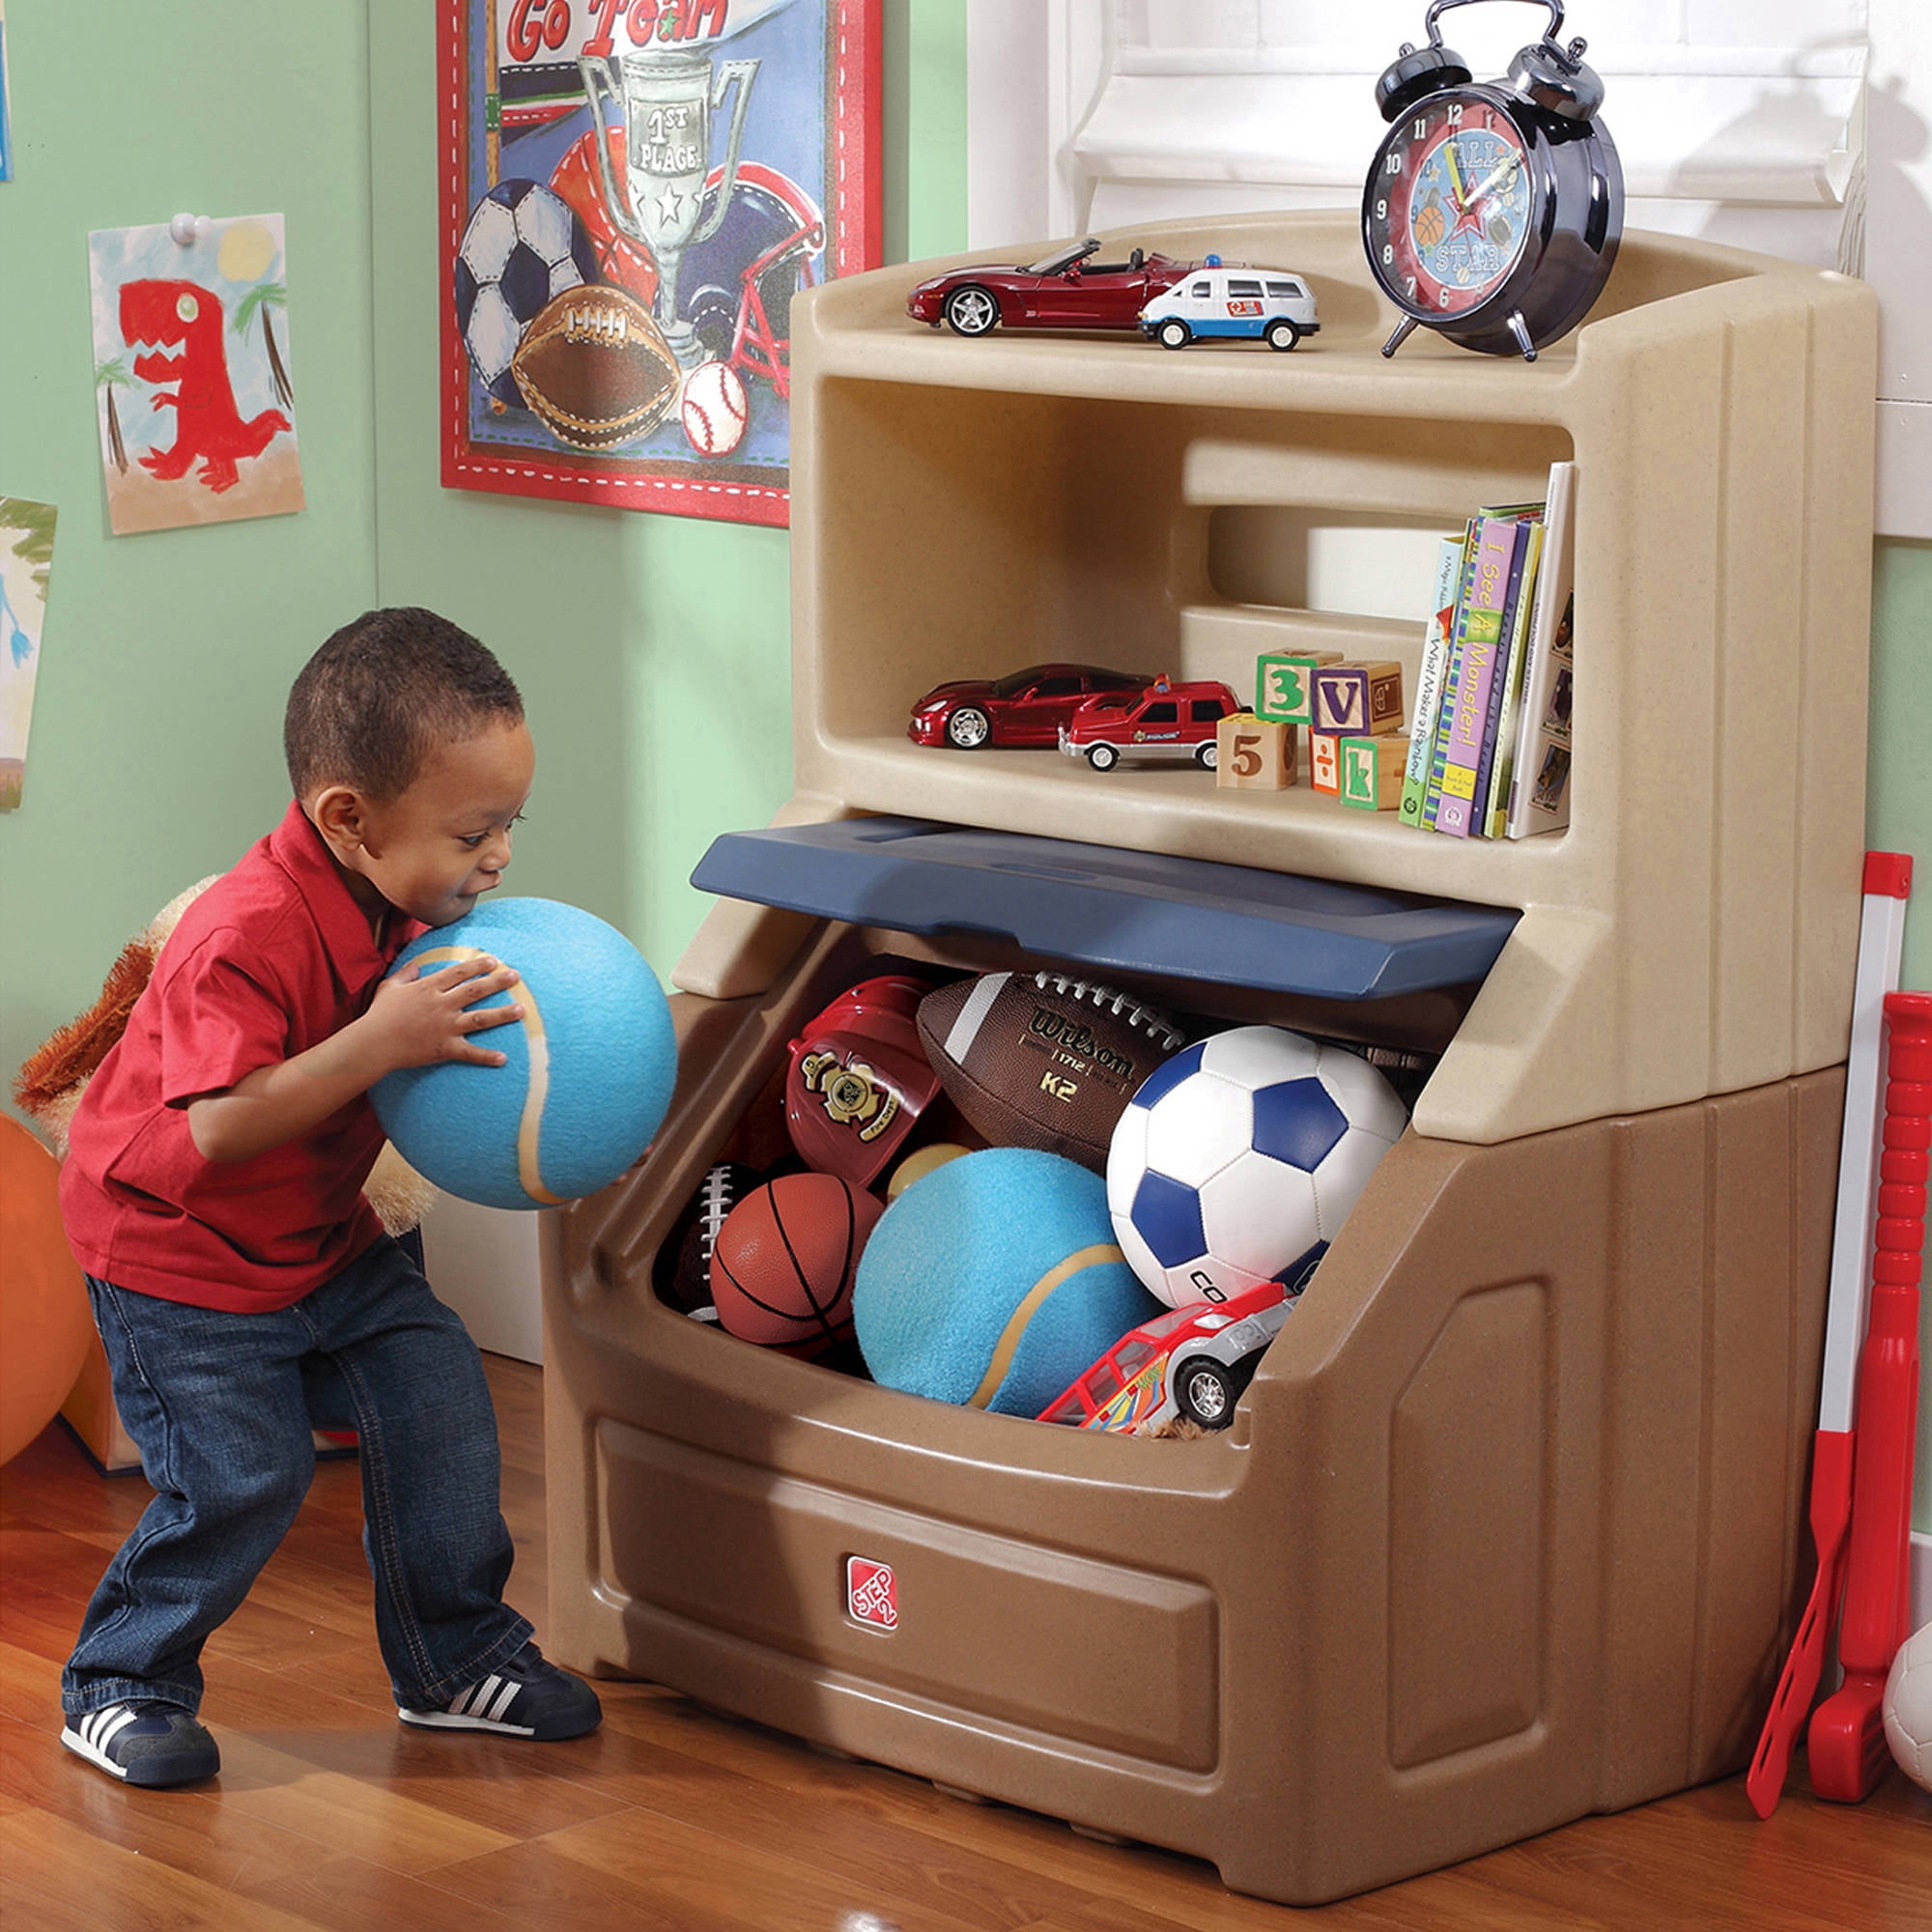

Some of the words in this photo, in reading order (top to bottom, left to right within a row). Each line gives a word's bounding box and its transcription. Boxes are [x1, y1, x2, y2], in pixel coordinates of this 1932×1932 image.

[506, 0, 571, 62] Go
[1413, 119, 1427, 140] 11
[1447, 104, 1463, 125] 12
[1385, 154, 1401, 174] 10
[1377, 199, 1387, 219] 9
[1383, 244, 1393, 265] 8
[1435, 242, 1500, 272] STAR
[1406, 276, 1416, 297] 7
[1438, 287, 1449, 308] 6
[1488, 543, 1505, 554] I
[1479, 563, 1500, 606] See
[1473, 612, 1493, 632] A
[1428, 639, 1441, 675] What
[1269, 669, 1304, 710] 3
[1418, 675, 1435, 718] Makes
[1456, 641, 1490, 748] Monster!
[1492, 667, 1501, 696] and
[1321, 682, 1359, 724] V
[1232, 735, 1263, 777] 5
[1409, 727, 1427, 786] Rainbow?
[1029, 1007, 1135, 1080] Wilson
[1059, 1053, 1086, 1072] 1712
[1040, 1071, 1078, 1102] K2
[853, 1568, 892, 1617] STEP
[877, 1597, 897, 1624] 2
